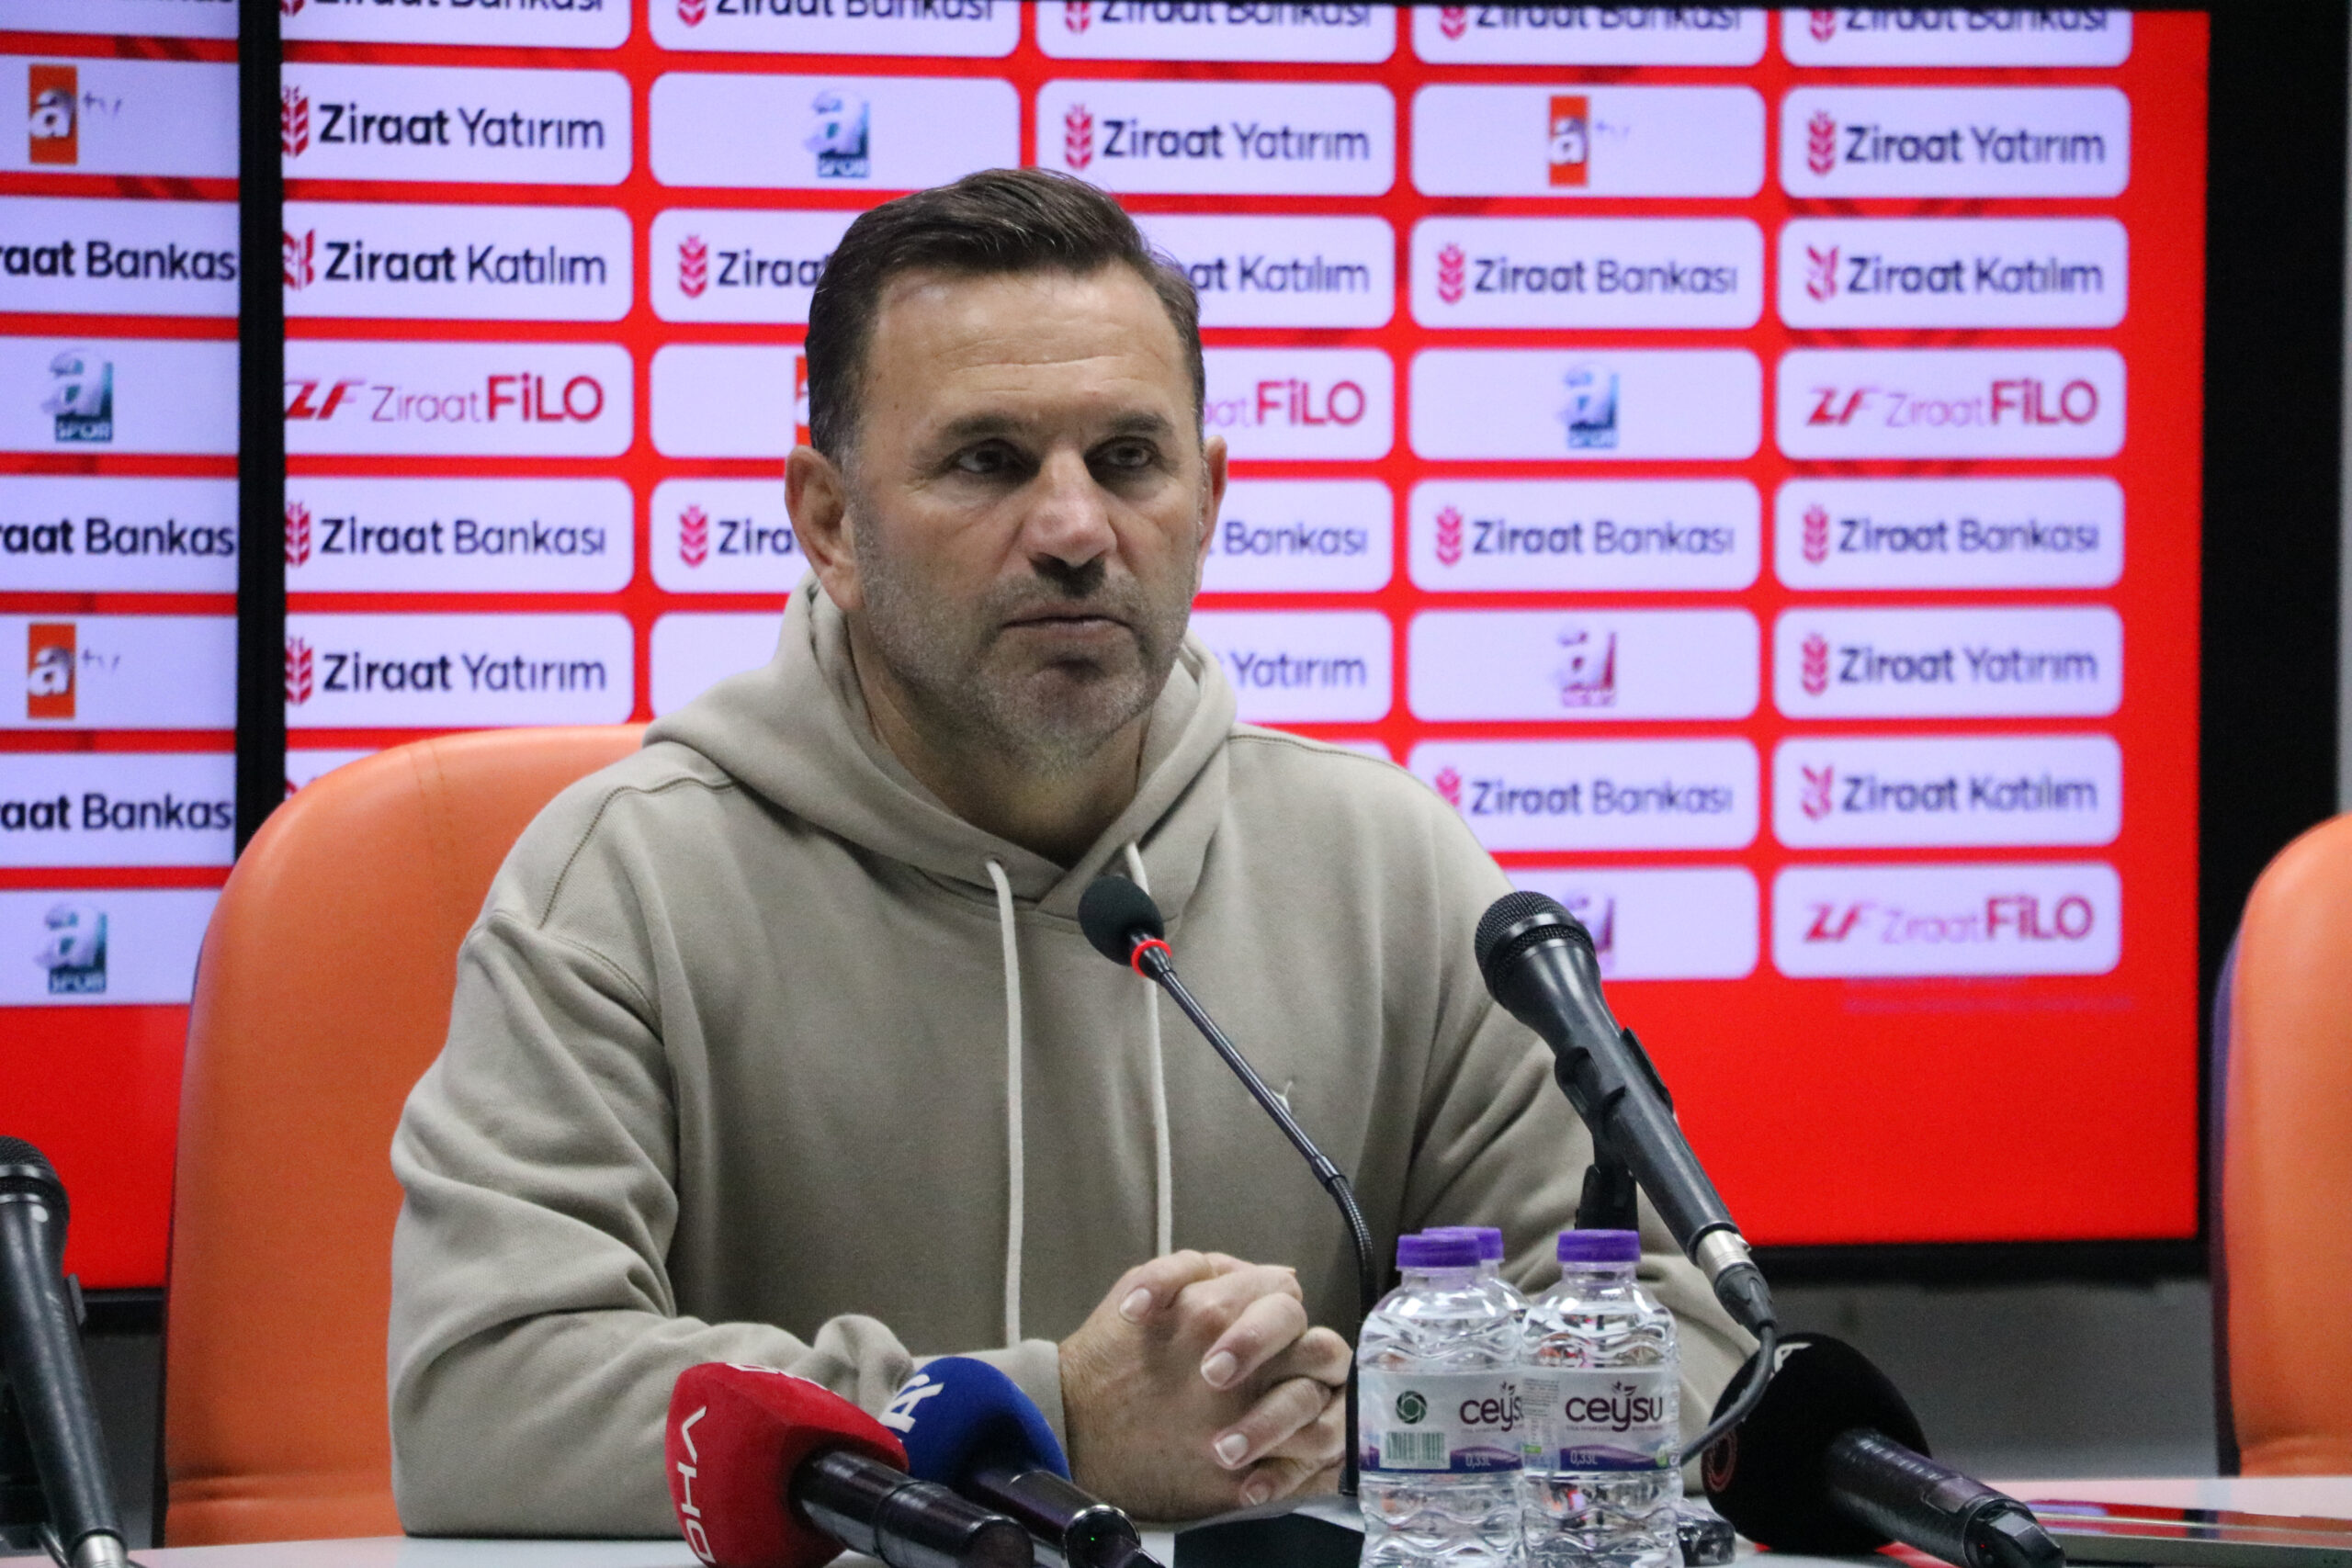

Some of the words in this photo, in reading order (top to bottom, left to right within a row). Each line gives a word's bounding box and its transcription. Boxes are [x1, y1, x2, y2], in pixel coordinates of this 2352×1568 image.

[318, 102, 450, 146] Ziraat
[457, 107, 605, 149] Yatırım
[1102, 118, 1224, 159] Ziraat
[1231, 122, 1370, 161] Yatırım
[1844, 124, 1963, 164] Ziraat
[1970, 126, 2107, 164] Yatırım
[324, 239, 457, 283] Ziraat
[467, 243, 606, 285] Katılım
[715, 244, 820, 289] Ziraa
[1238, 254, 1370, 293] Katılım
[1474, 256, 1587, 294] Ziraat
[1596, 258, 1737, 295] Bankası
[1847, 255, 1966, 294] Ziraat
[1974, 257, 2104, 294] Katılım
[369, 381, 482, 425] Ziraat
[1883, 389, 1986, 430] Ziraat
[320, 515, 444, 555] Ziraat
[453, 518, 605, 556] Bankası
[717, 517, 797, 555] Zira
[1223, 519, 1367, 556] Bankası
[1472, 519, 1584, 555] Ziraat
[1593, 519, 1735, 555] Bankası
[1838, 517, 1950, 554] Ziraat
[1957, 517, 2100, 553] Bankası
[322, 651, 452, 693] Ziraat
[460, 653, 606, 692] Yatırım
[1229, 652, 1367, 688] Yatırım
[1838, 646, 1955, 684] Ziraat
[1962, 647, 2099, 683] Yatırım
[1470, 780, 1582, 817] Ziraat
[1591, 778, 1734, 815] Bankası
[1841, 775, 1960, 813] Ziraat
[1968, 774, 2098, 811] Katılım
[1566, 1396, 1663, 1432] ceysu
[1570, 1450, 1599, 1466] 0,33L
